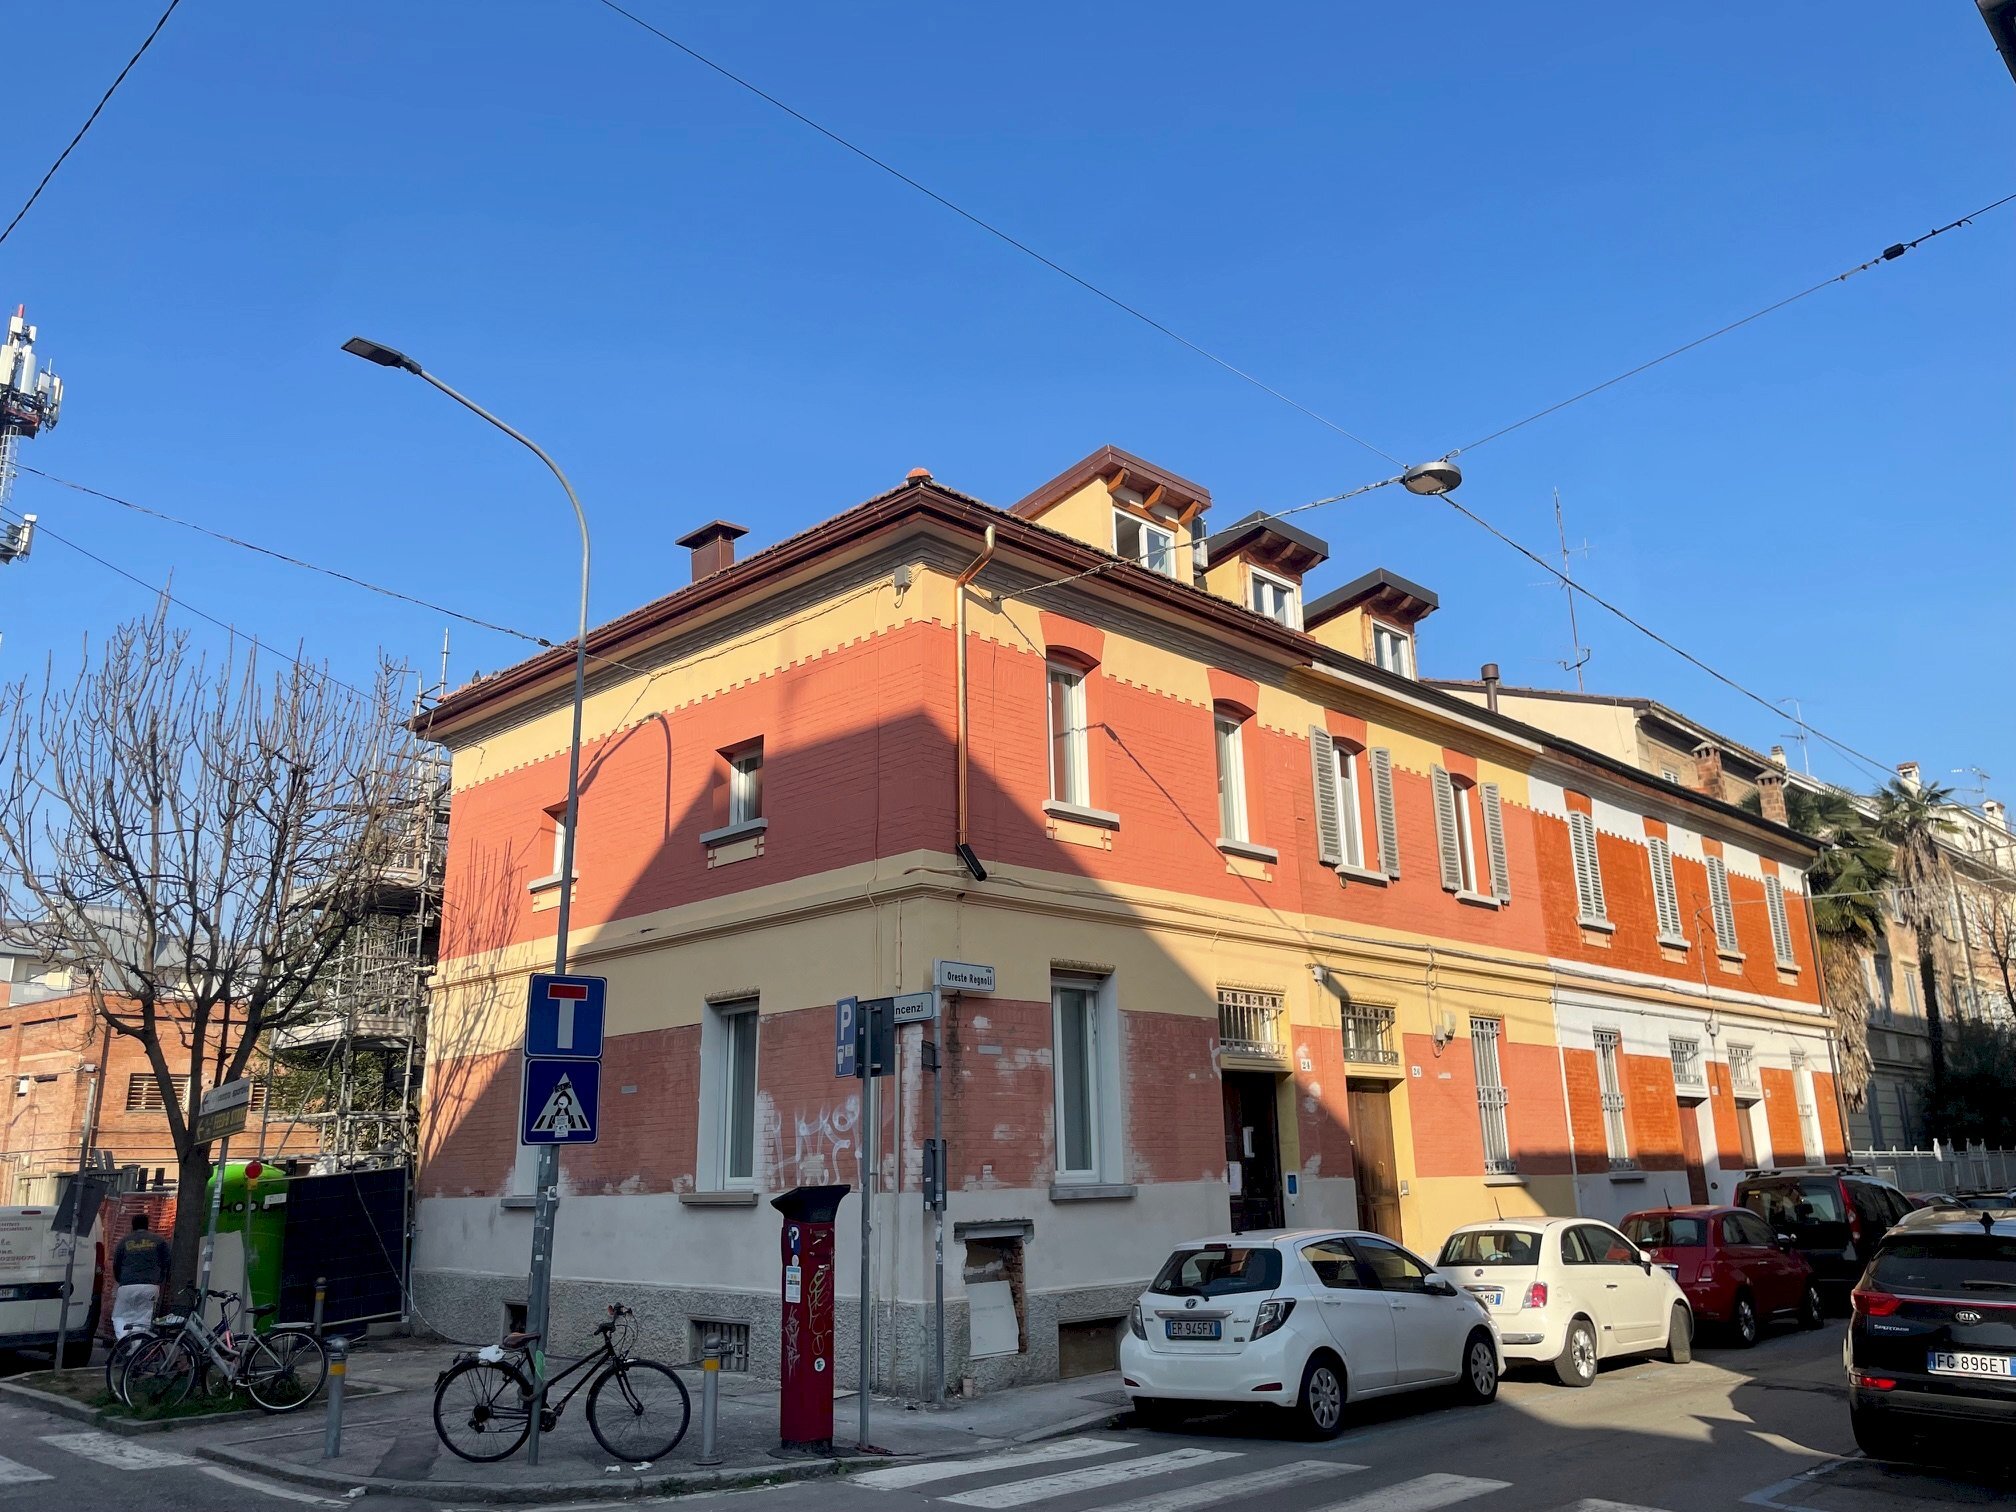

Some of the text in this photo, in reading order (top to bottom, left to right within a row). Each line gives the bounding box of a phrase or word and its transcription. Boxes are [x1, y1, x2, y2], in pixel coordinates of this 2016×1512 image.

[947, 971, 993, 986] Oreste Regnoli
[895, 1001, 924, 1016] ncenzi
[840, 1003, 852, 1041] P
[1960, 1312, 1977, 1321] KIA
[1172, 1322, 1214, 1336] ER 945FX
[1937, 1354, 2008, 1374] FG 896ET
